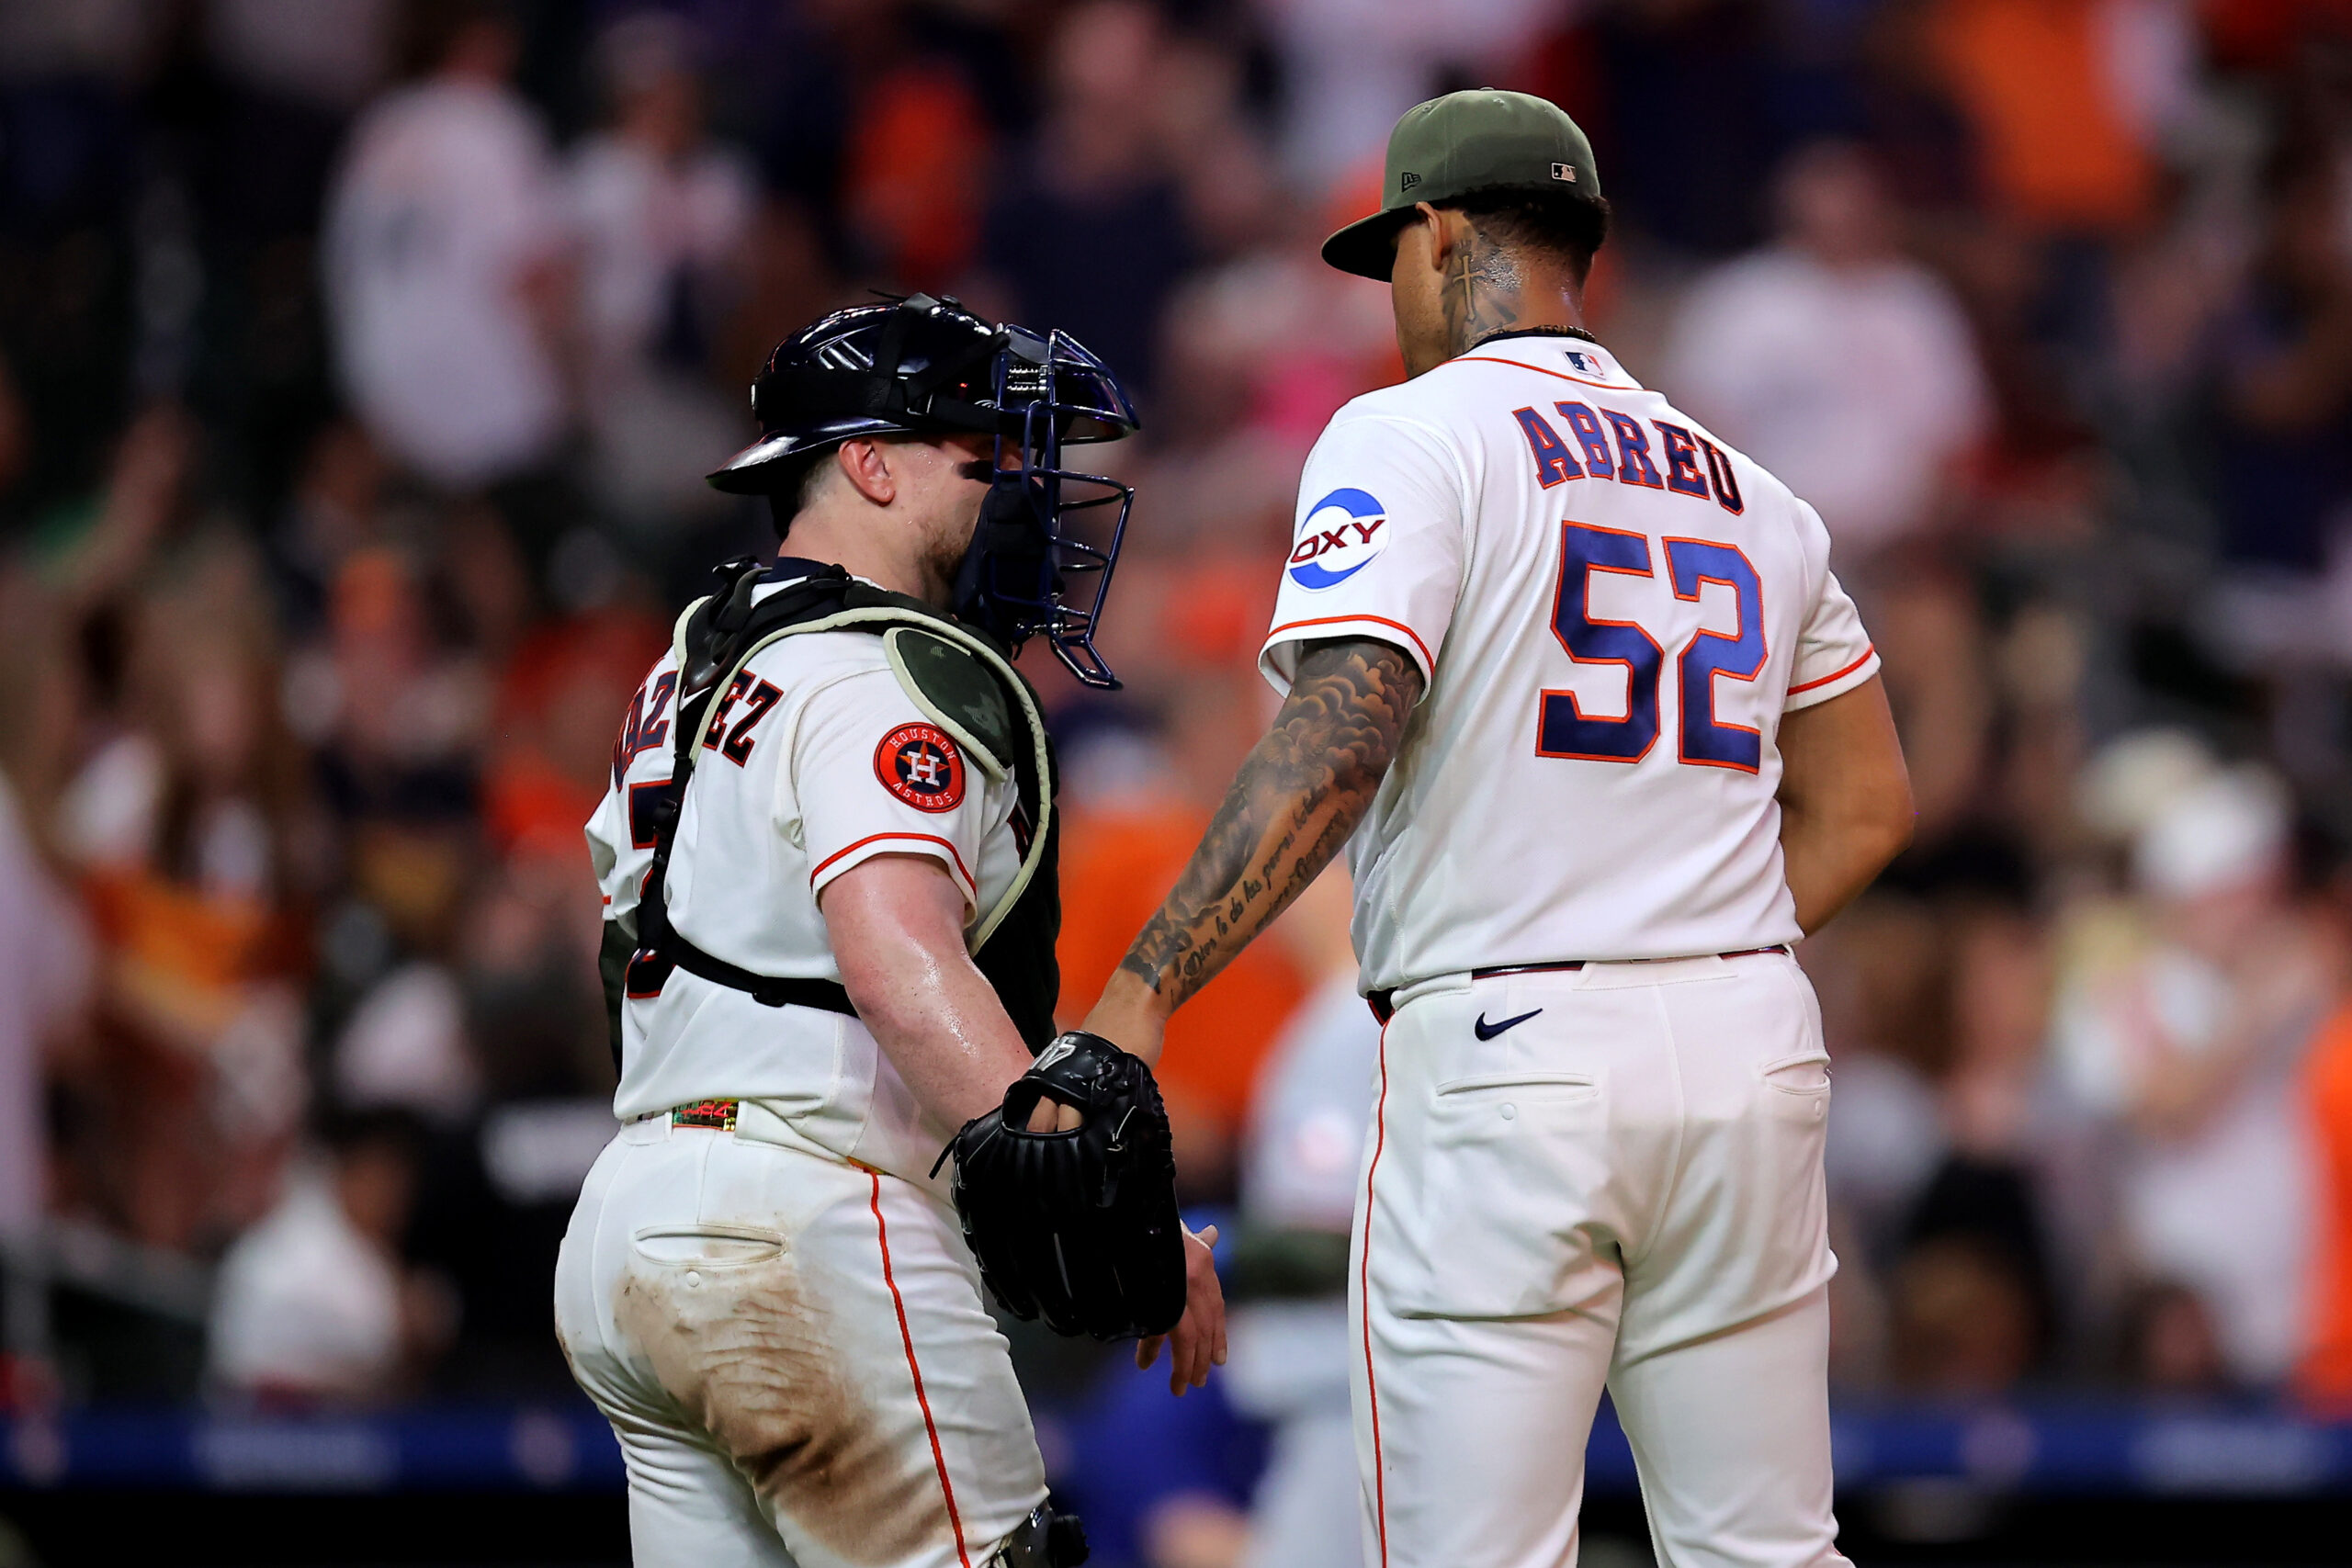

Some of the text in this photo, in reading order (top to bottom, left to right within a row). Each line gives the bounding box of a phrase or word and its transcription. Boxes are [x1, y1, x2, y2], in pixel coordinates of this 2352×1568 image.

[1512, 400, 1744, 516] ABREU
[1290, 519, 1385, 563] OXY
[1535, 519, 1769, 775] 52
[889, 728, 956, 760] HOUSTON
[907, 750, 941, 787] H
[893, 782, 954, 807] ASTROS
